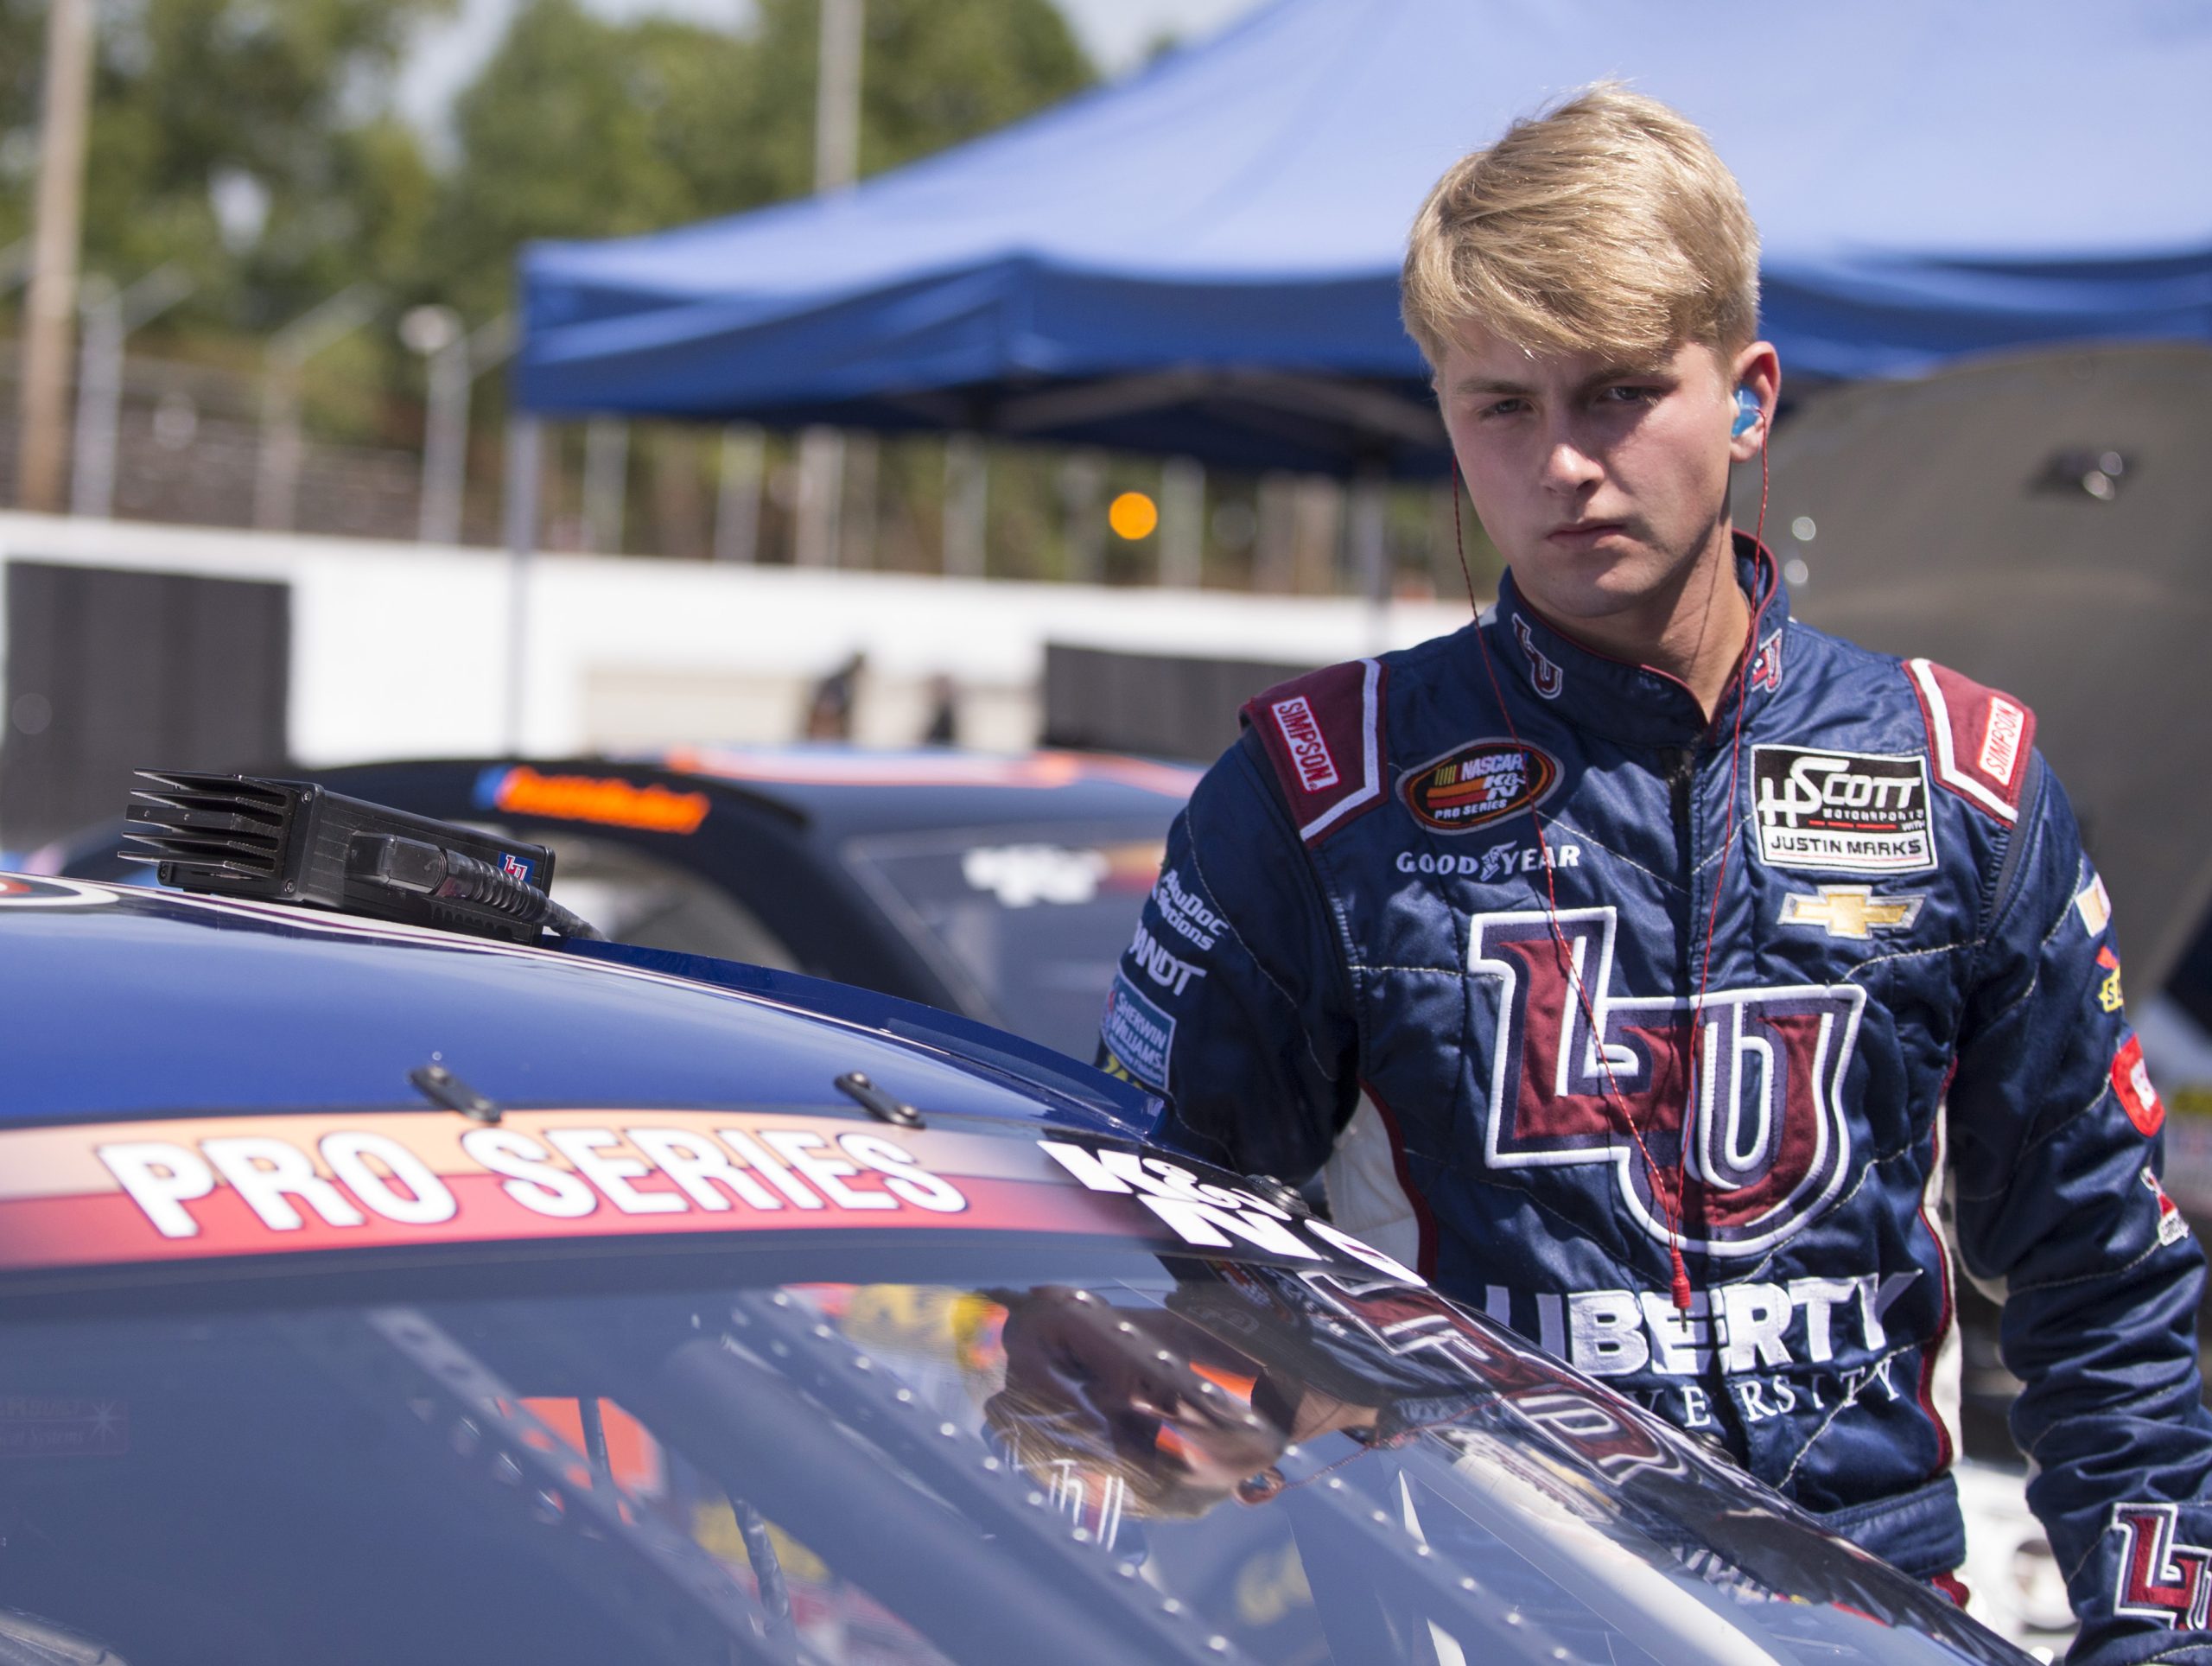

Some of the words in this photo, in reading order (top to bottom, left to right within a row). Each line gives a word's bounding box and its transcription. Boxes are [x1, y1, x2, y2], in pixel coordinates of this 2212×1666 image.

[1278, 701, 1333, 784] SIMPSON
[1986, 703, 2018, 776] SIMPSON
[1461, 753, 1525, 781] NASCAR
[1434, 807, 1460, 819] PRO
[1463, 798, 1508, 815] SERIES
[1822, 808, 1924, 821] MOTORSPORTS
[1771, 836, 1842, 854] JUSTIN
[1847, 840, 1923, 855] MARKS
[97, 1130, 458, 1238] PRO
[460, 1126, 969, 1218] SERIES
